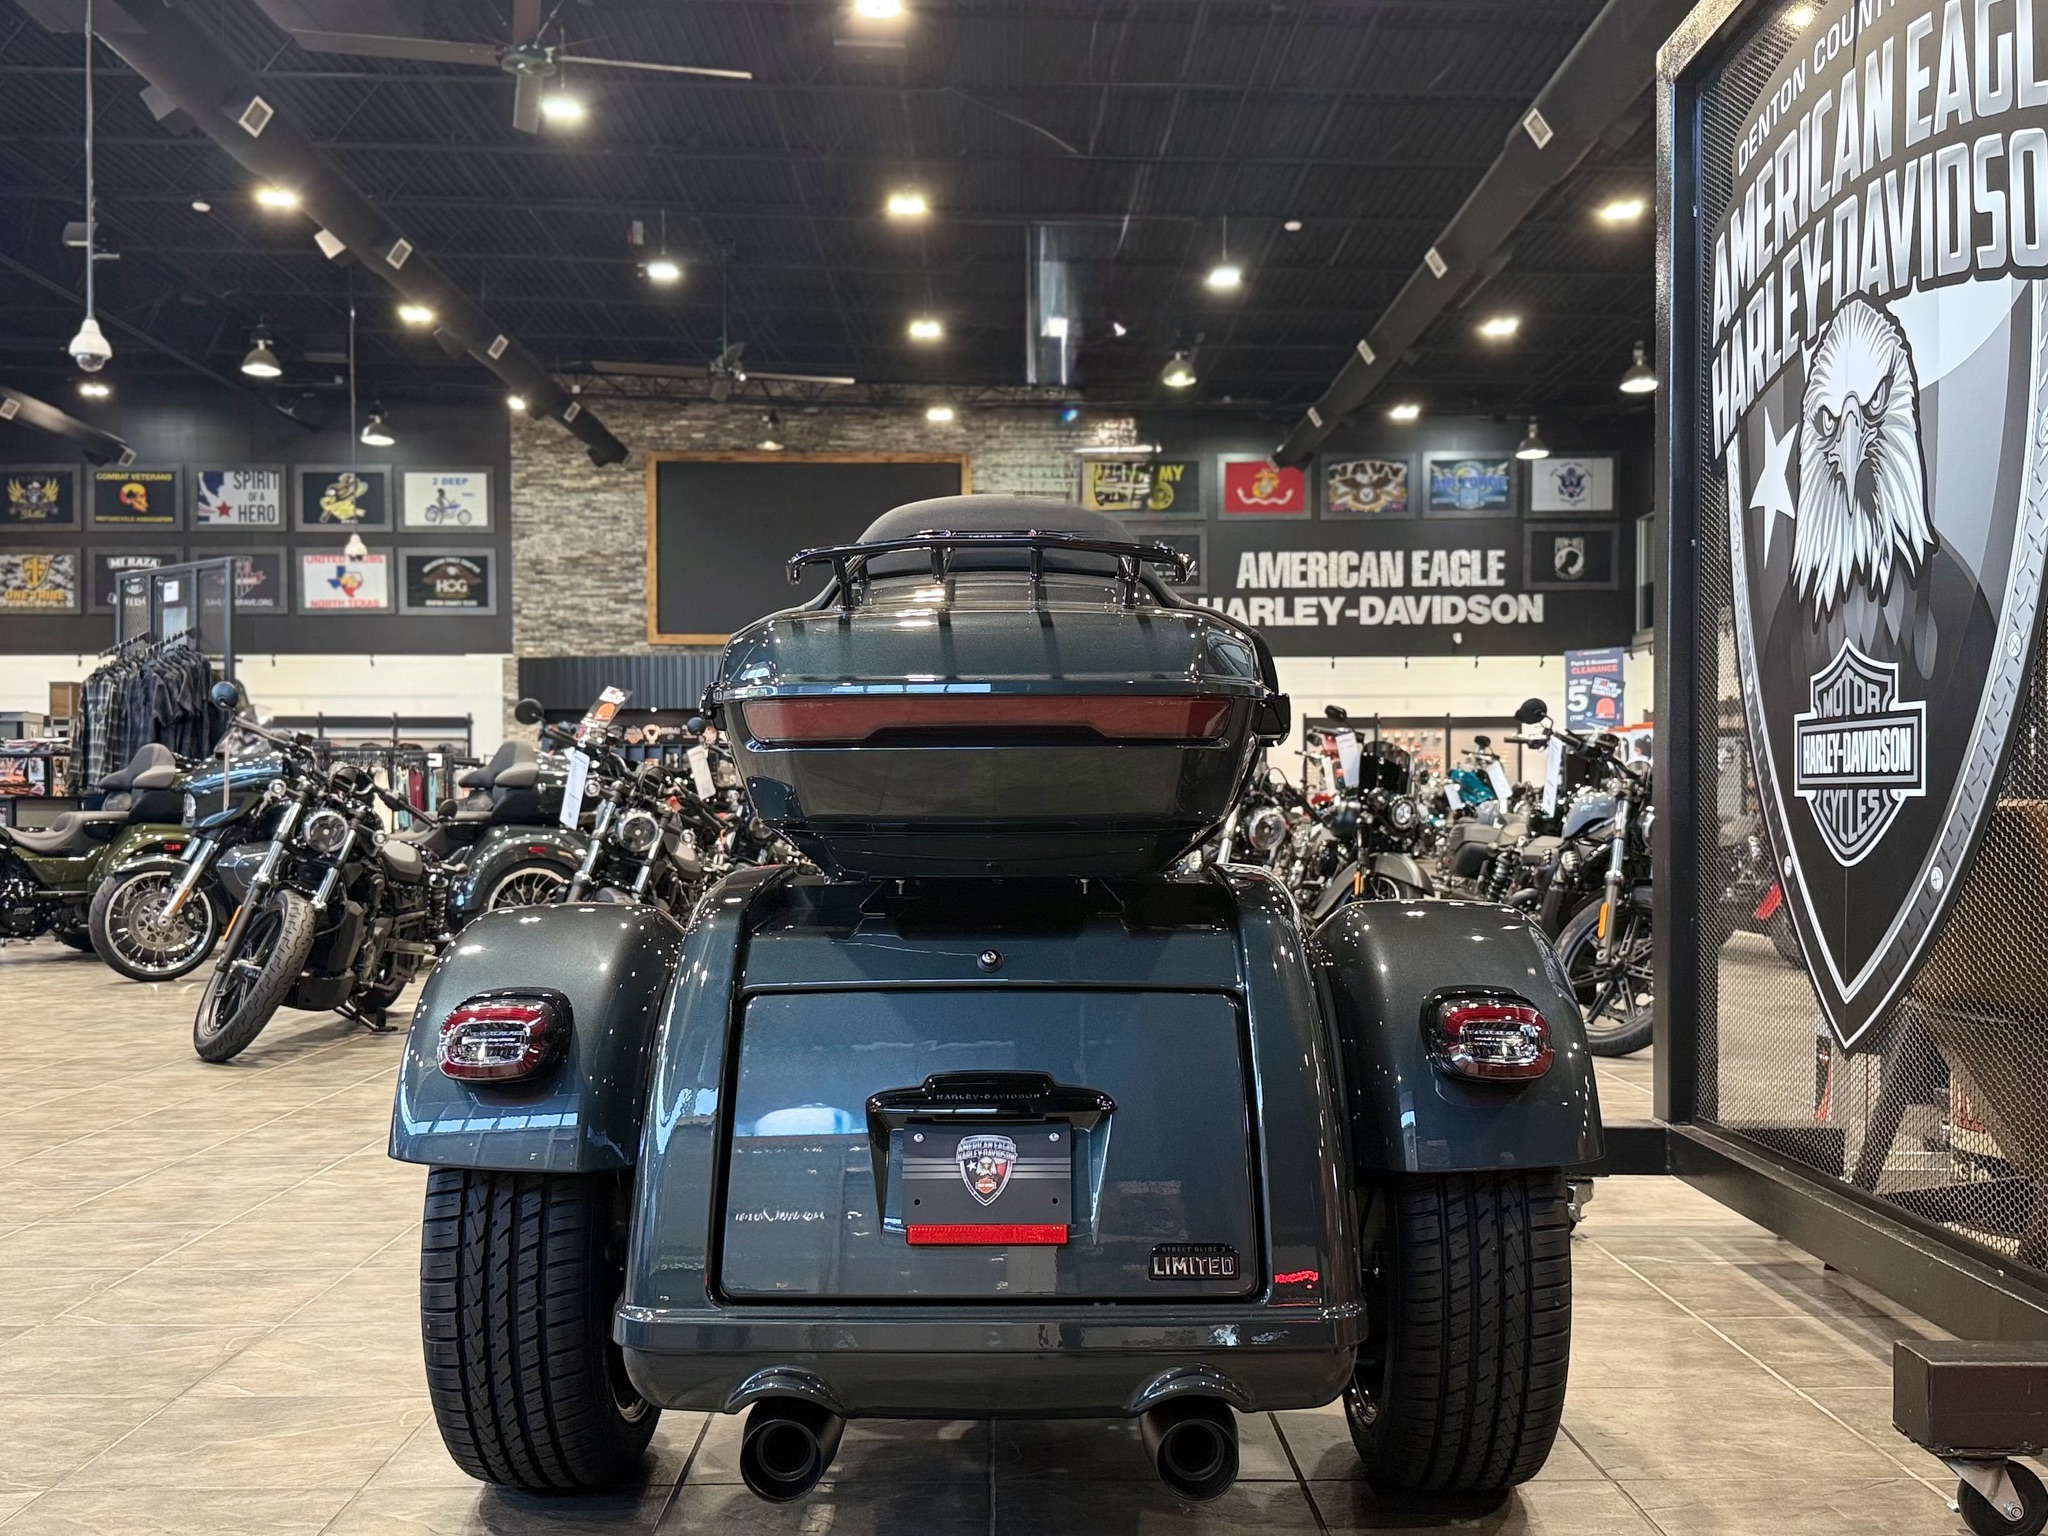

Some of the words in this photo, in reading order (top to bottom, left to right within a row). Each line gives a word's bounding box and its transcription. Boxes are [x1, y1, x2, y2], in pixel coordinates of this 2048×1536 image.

[1738, 59, 1806, 177] DENTON
[1813, 0, 1896, 75] COUN
[1712, 36, 1895, 348] AMERICAN
[96, 473, 129, 481] COMBAT
[131, 473, 173, 481] VETERANS
[1328, 462, 1405, 480] NAVY
[233, 471, 278, 490] SPIRIT
[248, 492, 258, 501] OF
[259, 492, 265, 501] A
[238, 505, 275, 522] HERO
[109, 558, 126, 568] MI
[127, 557, 159, 568] RAZA
[306, 555, 345, 564] UNITED
[1236, 551, 1404, 589] AMERICAN
[1411, 549, 1506, 588] EAGLE
[5, 589, 30, 600] ONE
[32, 589, 66, 600] TRIBE
[436, 579, 468, 593] HOG
[310, 600, 344, 608] NORTH
[349, 600, 379, 608] TEXAS
[1571, 664, 1619, 675] CLEARANCE
[1823, 668, 1882, 719] MOTOR
[1803, 727, 1912, 775] HARLEY-DAVIDSON
[1823, 789, 1880, 845] CYCLES
[1153, 1257, 1235, 1275] LIMITED
